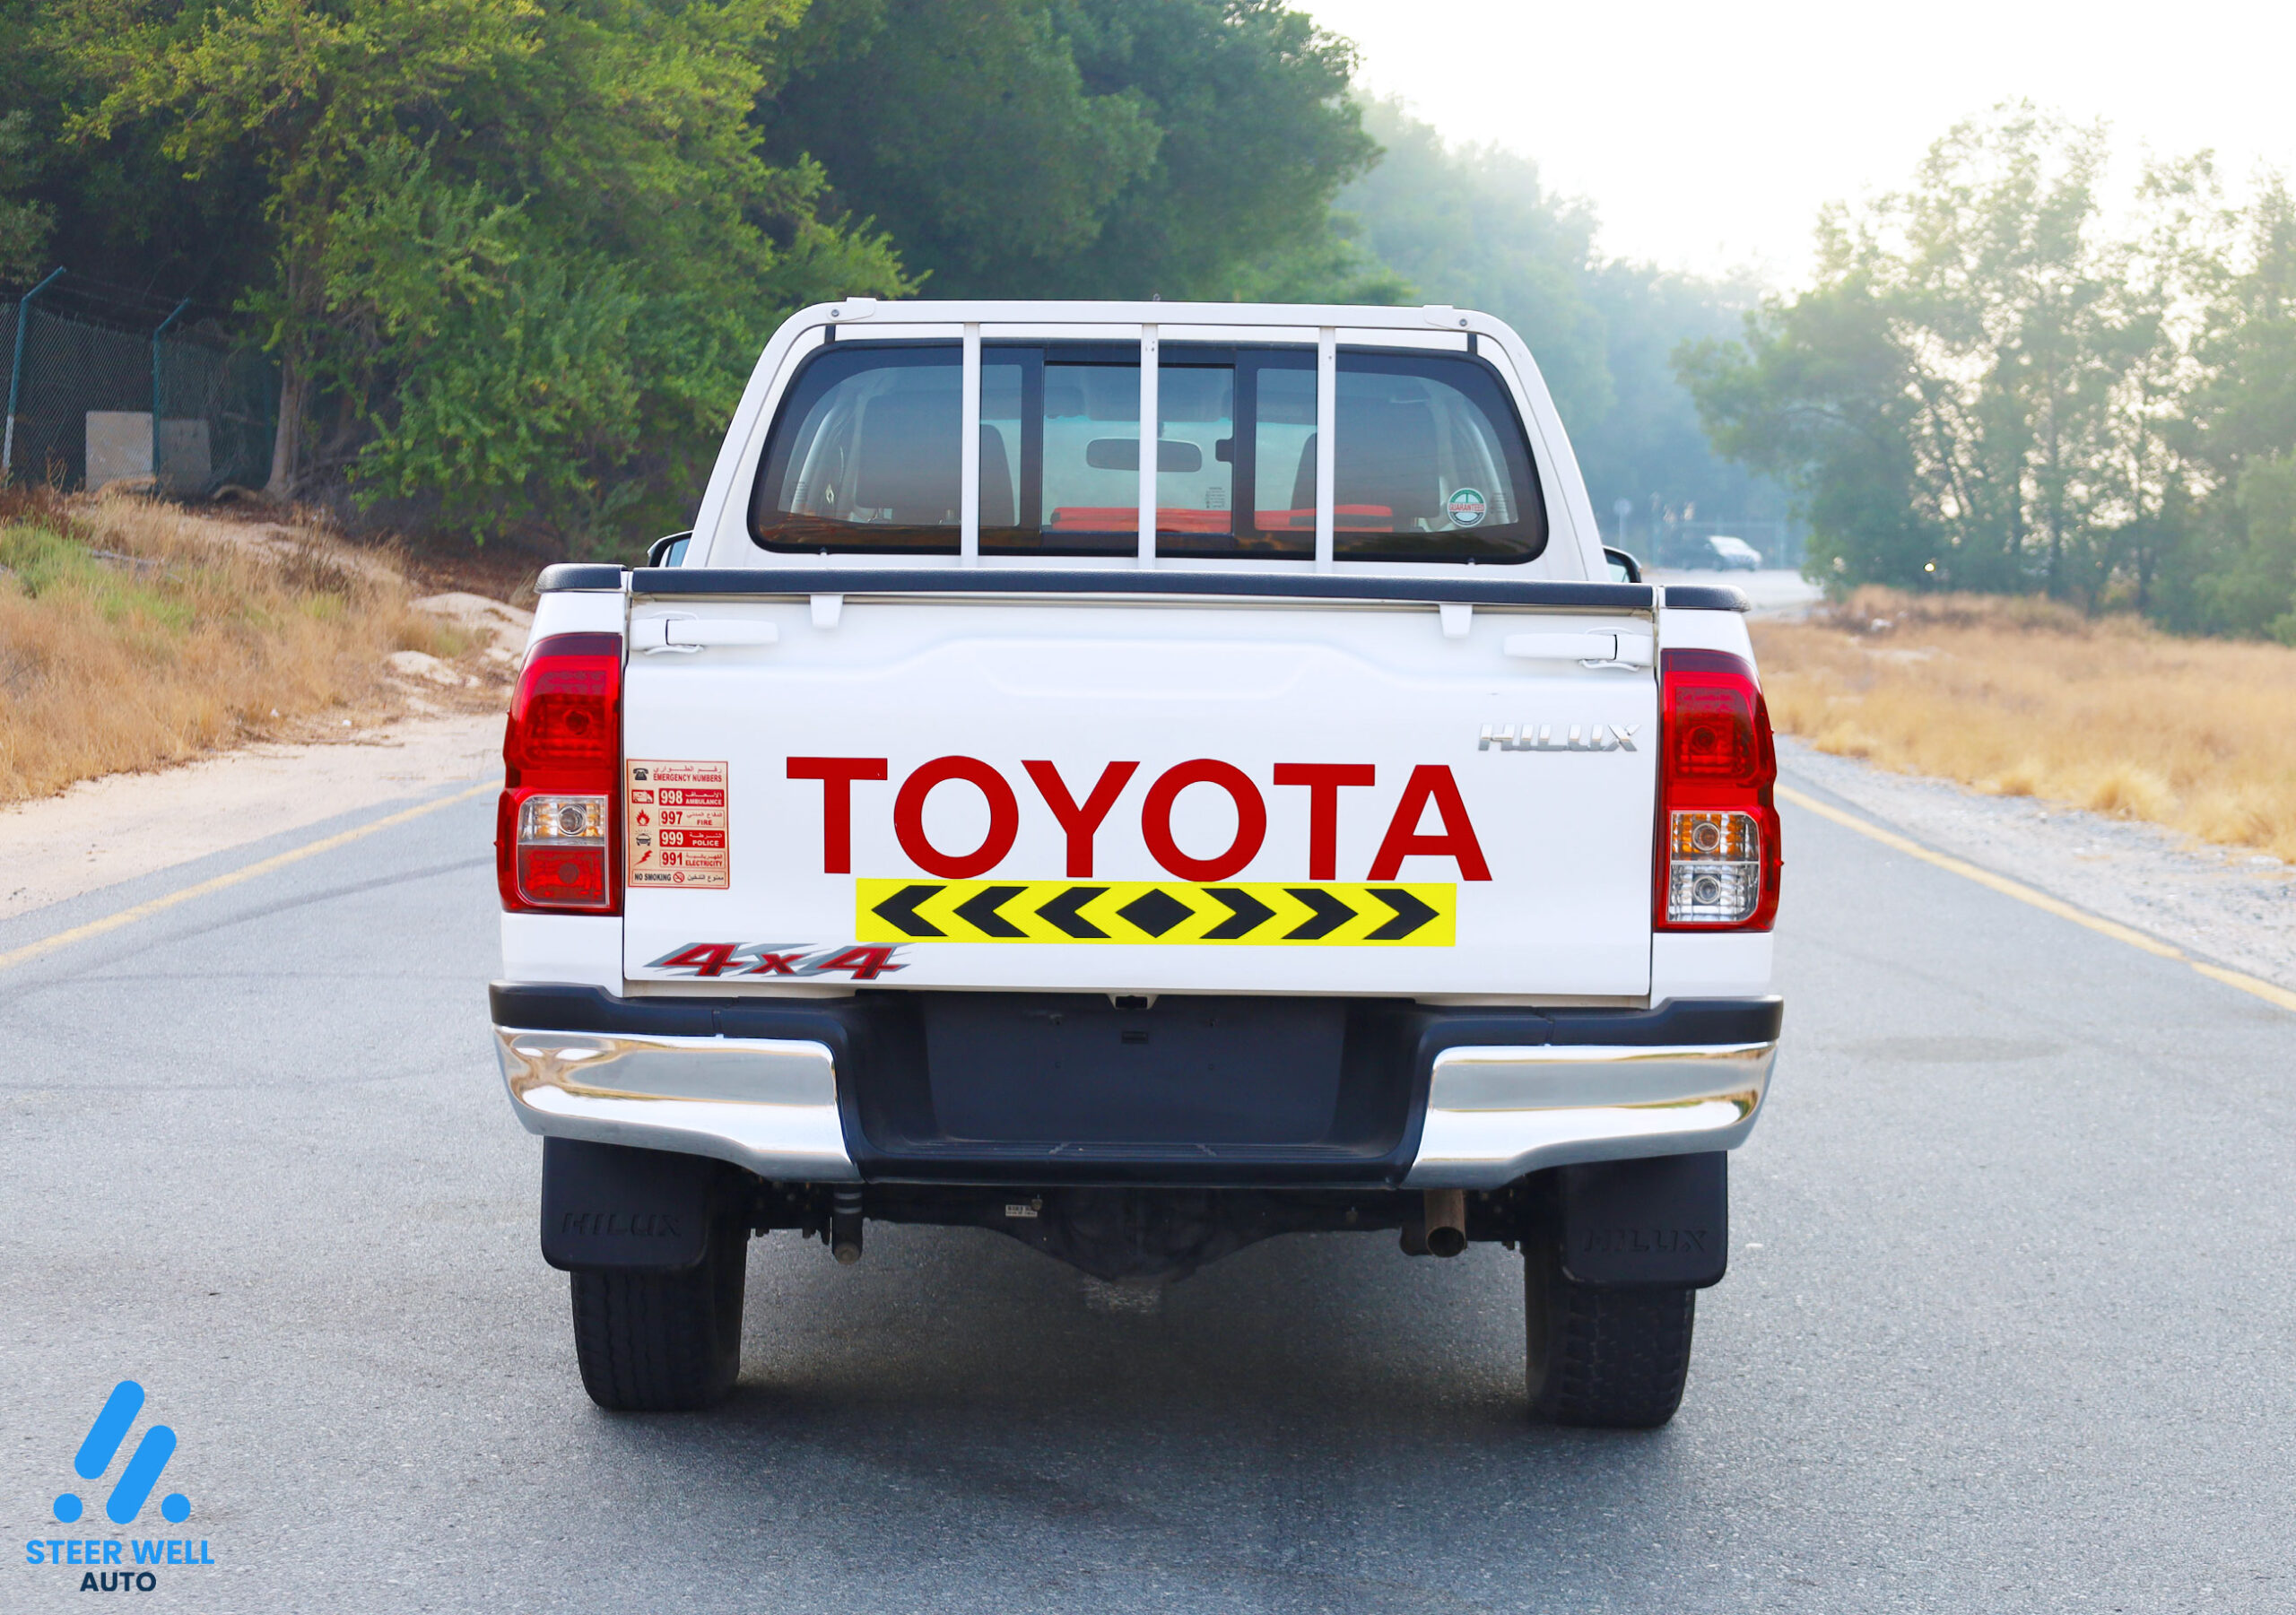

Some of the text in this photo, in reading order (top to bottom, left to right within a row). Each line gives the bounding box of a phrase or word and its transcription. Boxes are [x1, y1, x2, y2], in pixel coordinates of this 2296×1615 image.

[1478, 724, 1642, 751] HILUX
[653, 773, 722, 782] EMERGENCY NUMBERS
[660, 790, 683, 804] 998
[661, 811, 683, 825] 997
[787, 755, 1492, 882] TOYOTA
[661, 831, 684, 846] 999
[662, 851, 683, 865] 991
[634, 873, 672, 881] NO SMOKING
[561, 1212, 683, 1237] HILUX
